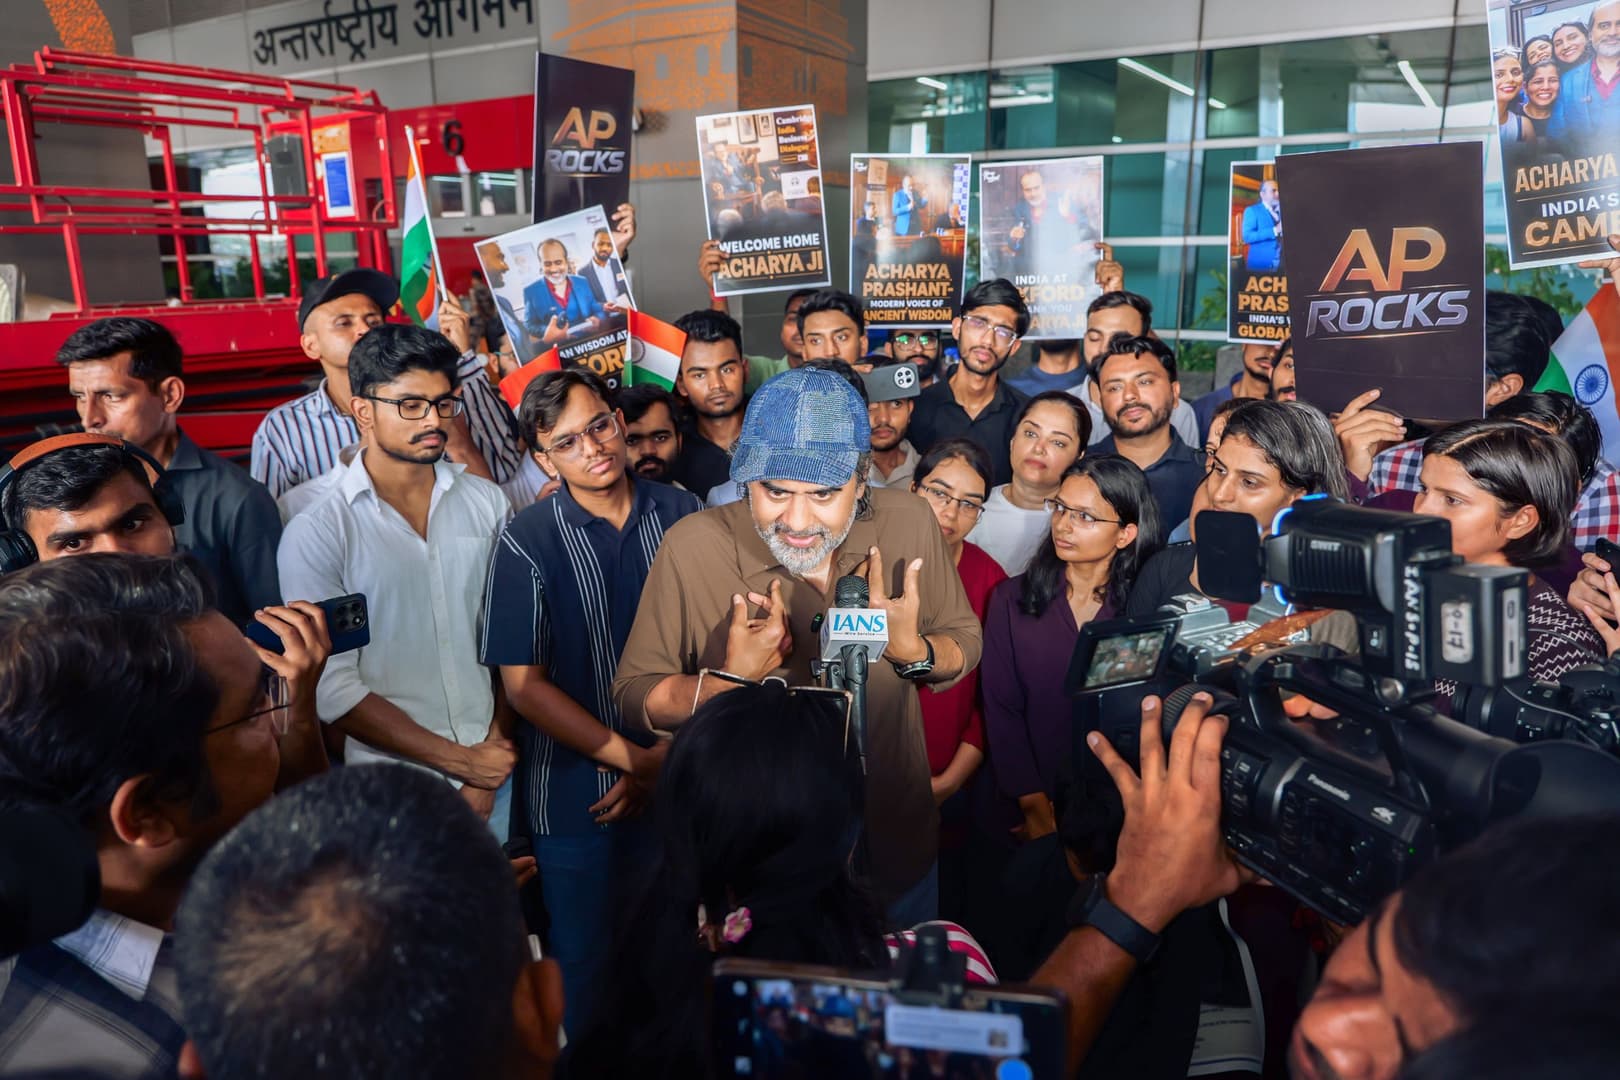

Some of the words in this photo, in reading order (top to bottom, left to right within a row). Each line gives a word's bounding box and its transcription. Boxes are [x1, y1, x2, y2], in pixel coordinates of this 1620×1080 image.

[443, 120, 464, 157] 6
[552, 106, 617, 149] AP
[545, 149, 625, 173] ROCKS
[1515, 152, 1619, 194] ACHARYA
[1541, 192, 1620, 217] INDIA'S
[719, 236, 781, 254] WELCOME
[783, 233, 820, 247] HOME
[718, 253, 805, 279] ACHARYA
[806, 250, 824, 272] JI
[865, 263, 950, 279] ACHARYA
[1319, 226, 1447, 292] AP
[1015, 274, 1049, 285] INDIA
[863, 309, 907, 321] ANCIENT
[908, 309, 952, 321] WISDOM
[870, 299, 905, 308] MODERN
[906, 299, 931, 307] VOICE
[932, 299, 945, 307] OF
[1305, 290, 1471, 338] ROCKS
[1249, 314, 1285, 325] INDIA'S
[574, 335, 616, 355] WISDOM
[617, 329, 628, 341] AT
[833, 613, 885, 632] IANS
